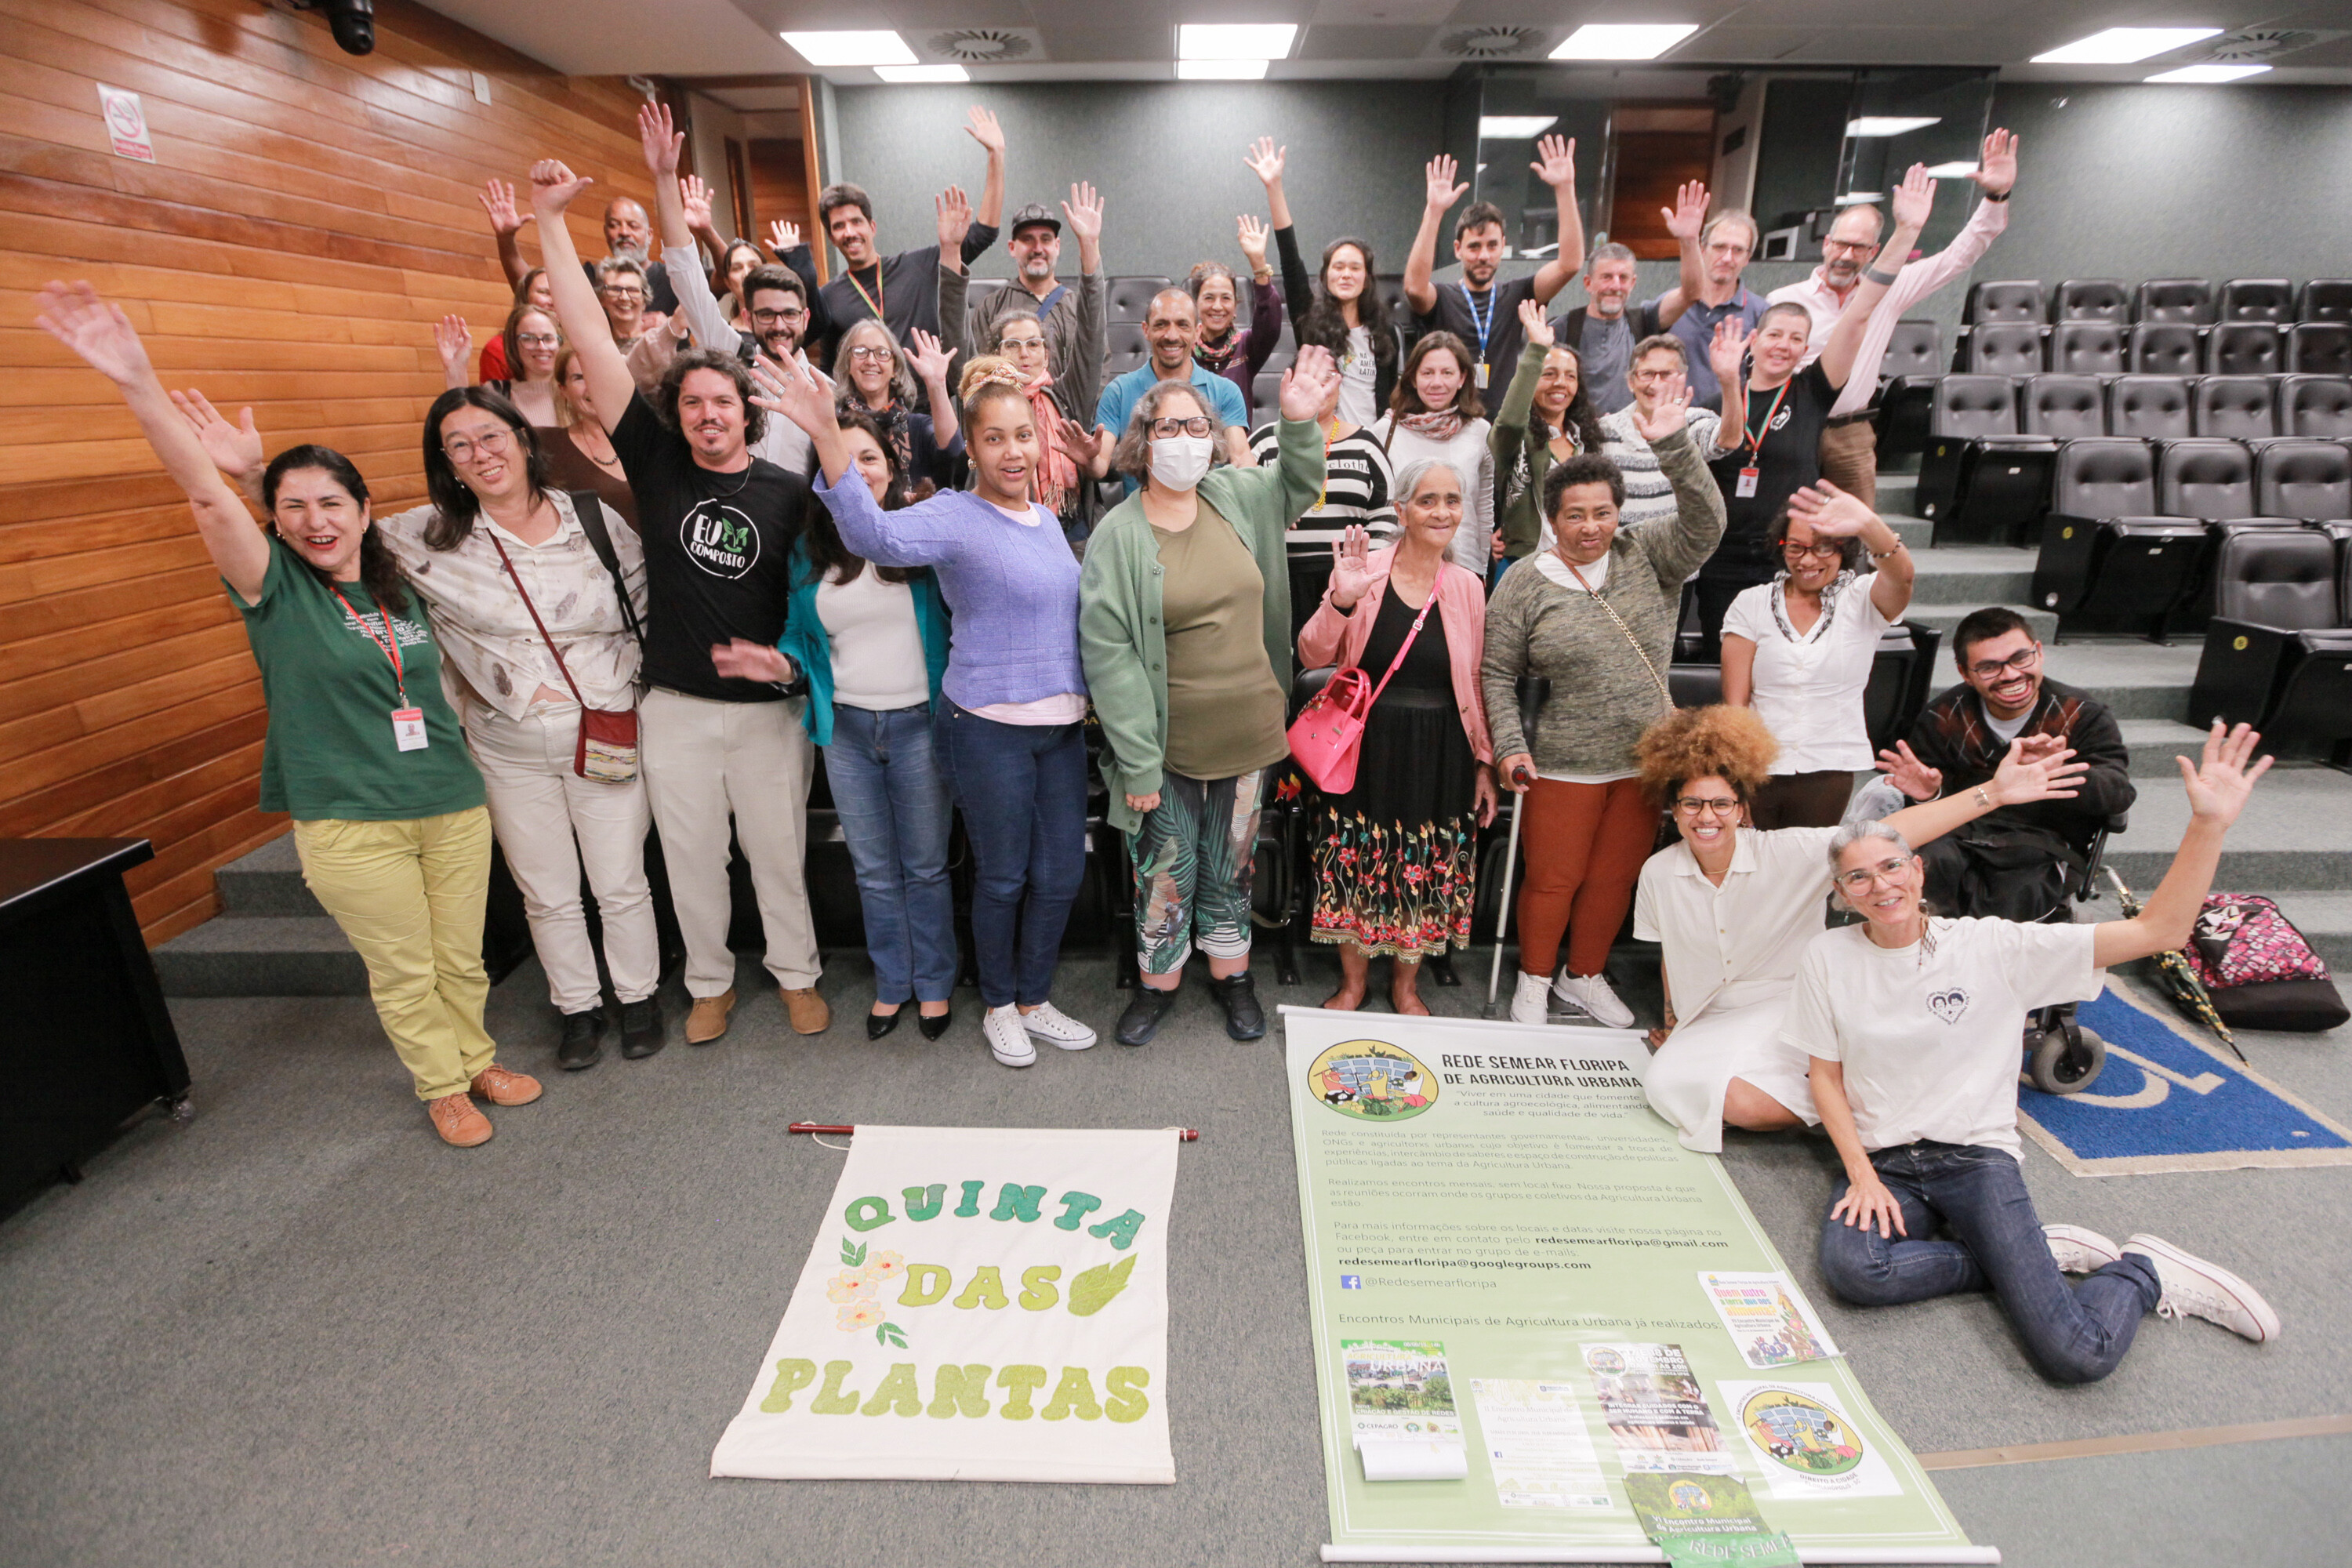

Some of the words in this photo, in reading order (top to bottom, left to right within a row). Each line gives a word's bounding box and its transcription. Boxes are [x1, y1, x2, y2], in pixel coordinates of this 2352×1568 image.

[693, 514, 723, 546] EU
[690, 541, 745, 568] COMPOSTO
[1442, 1054, 1486, 1069] REDE
[1489, 1056, 1557, 1069] SEMEAR
[1559, 1058, 1630, 1071] FLORIPA
[1444, 1073, 1465, 1085] DE
[1470, 1074, 1575, 1087] AGRICULTURA
[1577, 1076, 1643, 1088] URBANA
[1503, 1100, 1580, 1109] agroecológica,
[1528, 1109, 1581, 1118] qualidade
[1352, 1130, 1406, 1138] constituída
[1432, 1131, 1506, 1141] representantes
[1510, 1133, 1592, 1142] governamentais,
[1597, 1134, 1668, 1143] universidades,
[1371, 1140, 1429, 1149] agricultorxs
[1480, 1142, 1501, 1151] cujo
[1507, 1142, 1548, 1151] objetivo
[1324, 1149, 1390, 1158] experiências,
[1391, 1149, 1452, 1158] intercâmbio
[1565, 1152, 1623, 1163] construção
[1637, 1153, 1679, 1163] políticas
[1325, 1158, 1368, 1167] públicas
[1372, 1159, 1407, 1168] ligadas
[1473, 1160, 1530, 1170] Agricultura
[1523, 1181, 1549, 1189] local
[1343, 1189, 1389, 1197] reuniões
[1485, 1192, 1523, 1200] grupos
[1534, 1192, 1582, 1200] coletivos
[1600, 1193, 1661, 1203] Agricultura
[1661, 1195, 1703, 1203] Urbana
[844, 1180, 1145, 1251] QUINTA
[1392, 1222, 1462, 1232] informações
[1516, 1224, 1549, 1233] locais
[1563, 1225, 1593, 1234] datas
[1595, 1226, 1625, 1235] visite
[1664, 1227, 1704, 1237] página
[1335, 1232, 1394, 1242] Facebook,
[1505, 1236, 1530, 1245] pelo
[1535, 1236, 1730, 1249] redesemearfloripa@gmail.com
[1356, 1247, 1384, 1255] peça
[1388, 1247, 1414, 1255] para
[1475, 1248, 1511, 1258] grupo
[1515, 1247, 1529, 1256] de
[1533, 1247, 1579, 1257] e-mails:
[1338, 1257, 1592, 1270] redesemearfloripa@googlegroups.com
[897, 1263, 1062, 1311] DAS
[1365, 1276, 1497, 1290] @Redesemearfloripa
[1713, 1288, 1742, 1298] Quem
[1740, 1288, 1767, 1297] nutre
[1725, 1305, 1777, 1316] alimenta?
[1339, 1314, 1404, 1324] Encontros
[1409, 1315, 1480, 1327] Municipais
[1484, 1316, 1501, 1325] de
[1505, 1316, 1579, 1328] Agricultura
[1583, 1318, 1632, 1327] Urbana
[1635, 1318, 1646, 1329] já
[1651, 1319, 1722, 1330] realizados:
[1653, 1348, 1663, 1357] 18
[1370, 1359, 1443, 1372] URBANA
[759, 1358, 1151, 1424] PLANTAS
[1652, 1515, 1662, 1524] VI
[1656, 1523, 1668, 1532] de
[1668, 1525, 1721, 1534] Agricultura
[1690, 1539, 1737, 1559] REDE
